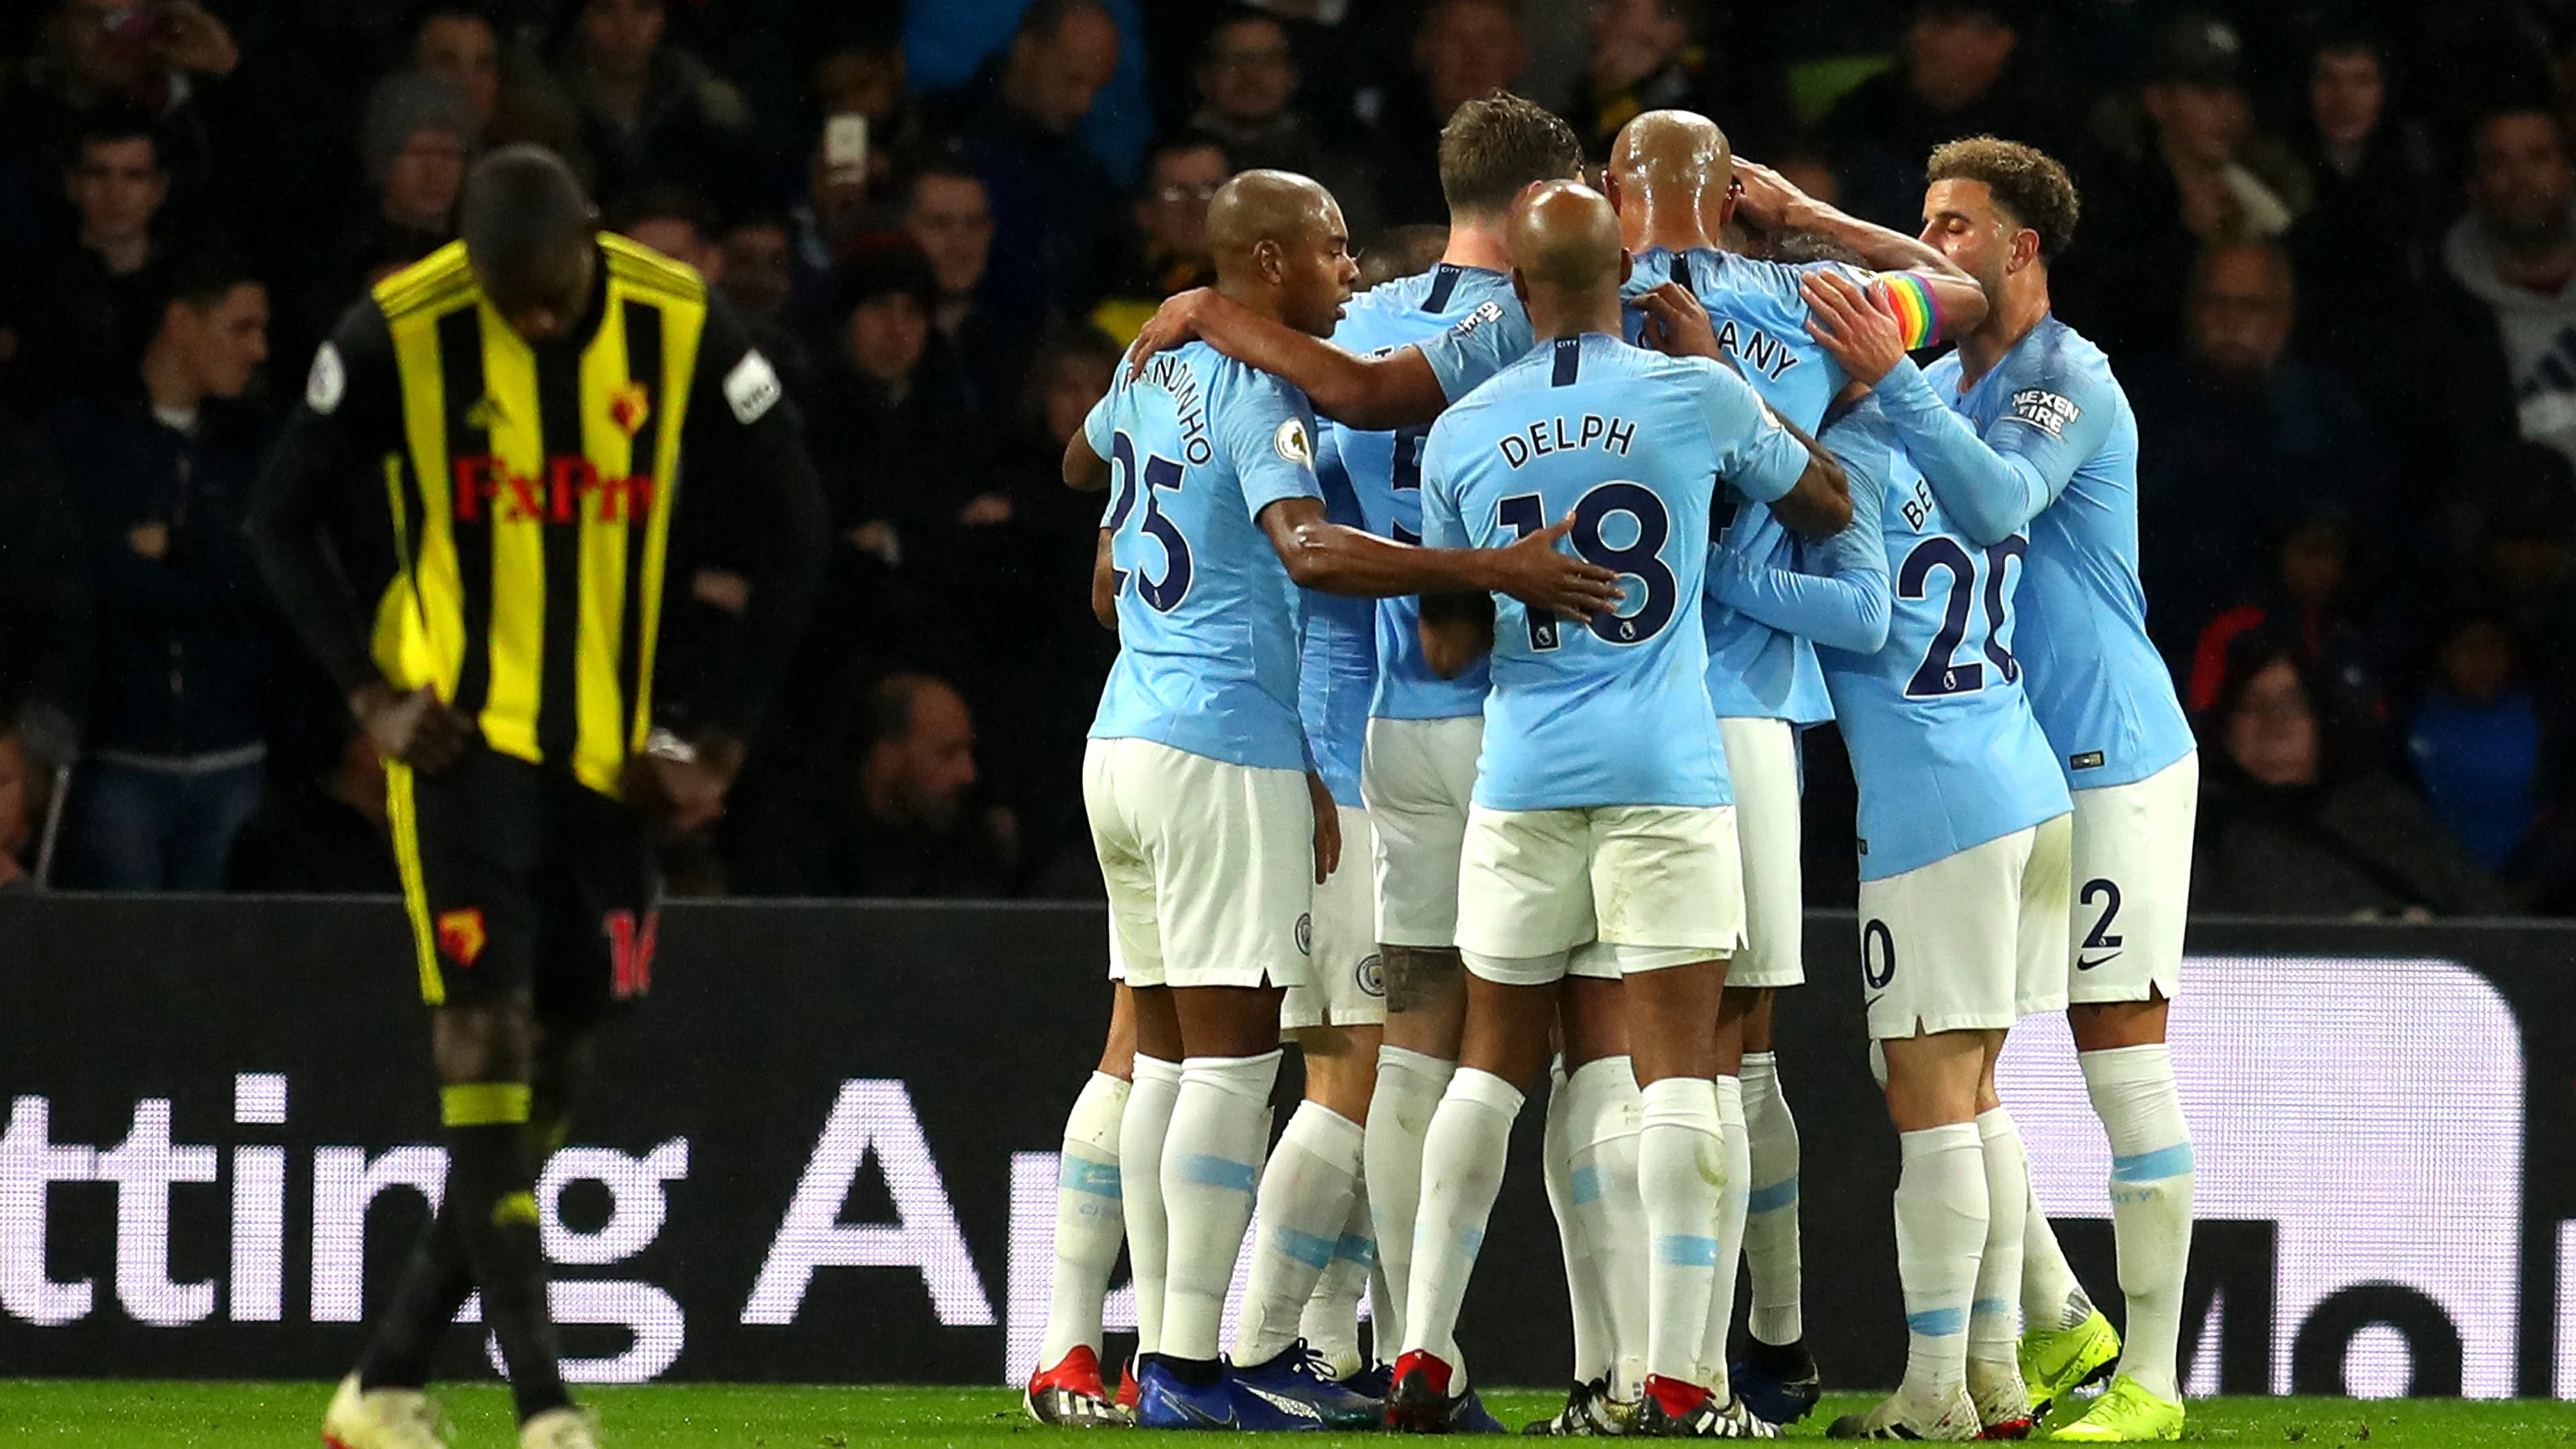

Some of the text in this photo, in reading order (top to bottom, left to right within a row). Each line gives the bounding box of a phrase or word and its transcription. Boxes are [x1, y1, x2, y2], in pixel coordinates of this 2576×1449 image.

[1498, 413, 1637, 470] DELPH
[2011, 390, 2080, 423] NEXEN
[2018, 404, 2064, 433] TIRE
[1113, 428, 1194, 613] 25
[1498, 480, 1678, 652] 18
[1896, 535, 2029, 698] 20
[2079, 878, 2123, 949] 2
[1863, 919, 1896, 990] 0
